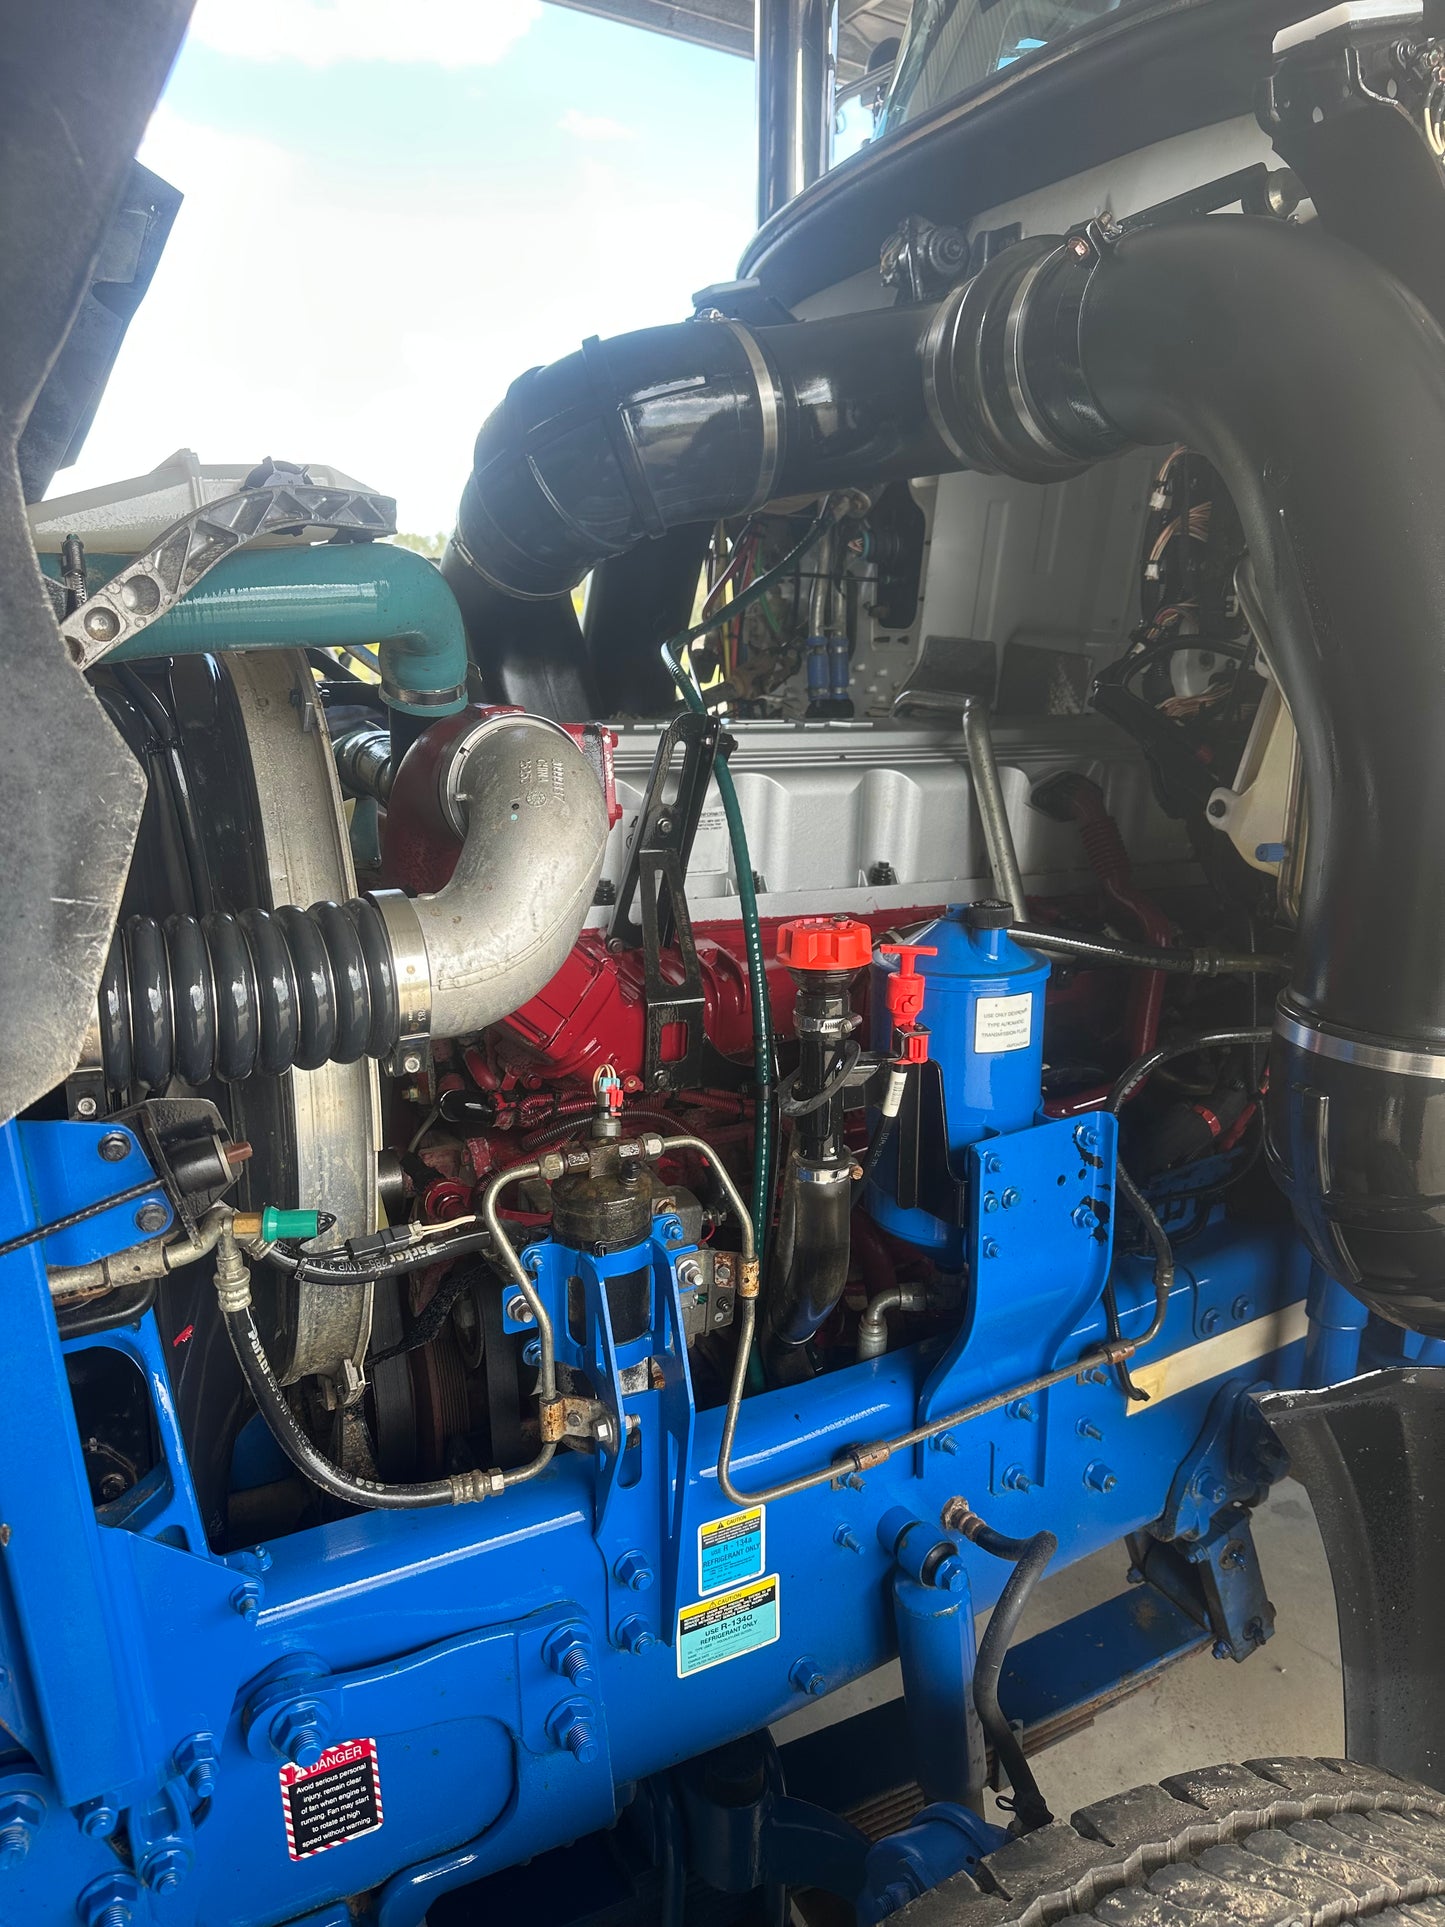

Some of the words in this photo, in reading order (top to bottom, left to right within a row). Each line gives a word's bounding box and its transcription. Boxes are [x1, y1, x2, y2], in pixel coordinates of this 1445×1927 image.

[390, 1242, 437, 1264] Parker
[247, 1325, 271, 1375] Parker
[726, 1515, 747, 1525] CAUTION
[703, 1549, 745, 1568] REFRIGERANT
[745, 1542, 760, 1553] ONLY
[717, 1592, 742, 1606] CAUTION
[700, 1627, 741, 1645] REFRIGERANT
[742, 1619, 758, 1630] ONLY
[705, 1627, 719, 1637] USE
[721, 1614, 753, 1631] R-134a
[310, 1745, 363, 1774] DANGER
[296, 1783, 314, 1794] Avoid
[315, 1775, 339, 1788] serious
[339, 1763, 367, 1780] personal
[323, 1783, 346, 1796] remain
[346, 1776, 362, 1787] clear
[300, 1812, 326, 1827] running.
[327, 1807, 340, 1816] Fan
[340, 1802, 354, 1812] may
[355, 1795, 370, 1806] start
[309, 1804, 319, 1812] fan
[320, 1796, 338, 1808] when
[338, 1788, 360, 1802] engine
[302, 1835, 322, 1848] speed
[322, 1825, 346, 1840] without
[346, 1816, 373, 1831] warning.
[320, 1818, 339, 1830] rotate
[339, 1815, 346, 1823] at
[346, 1810, 361, 1821] high
